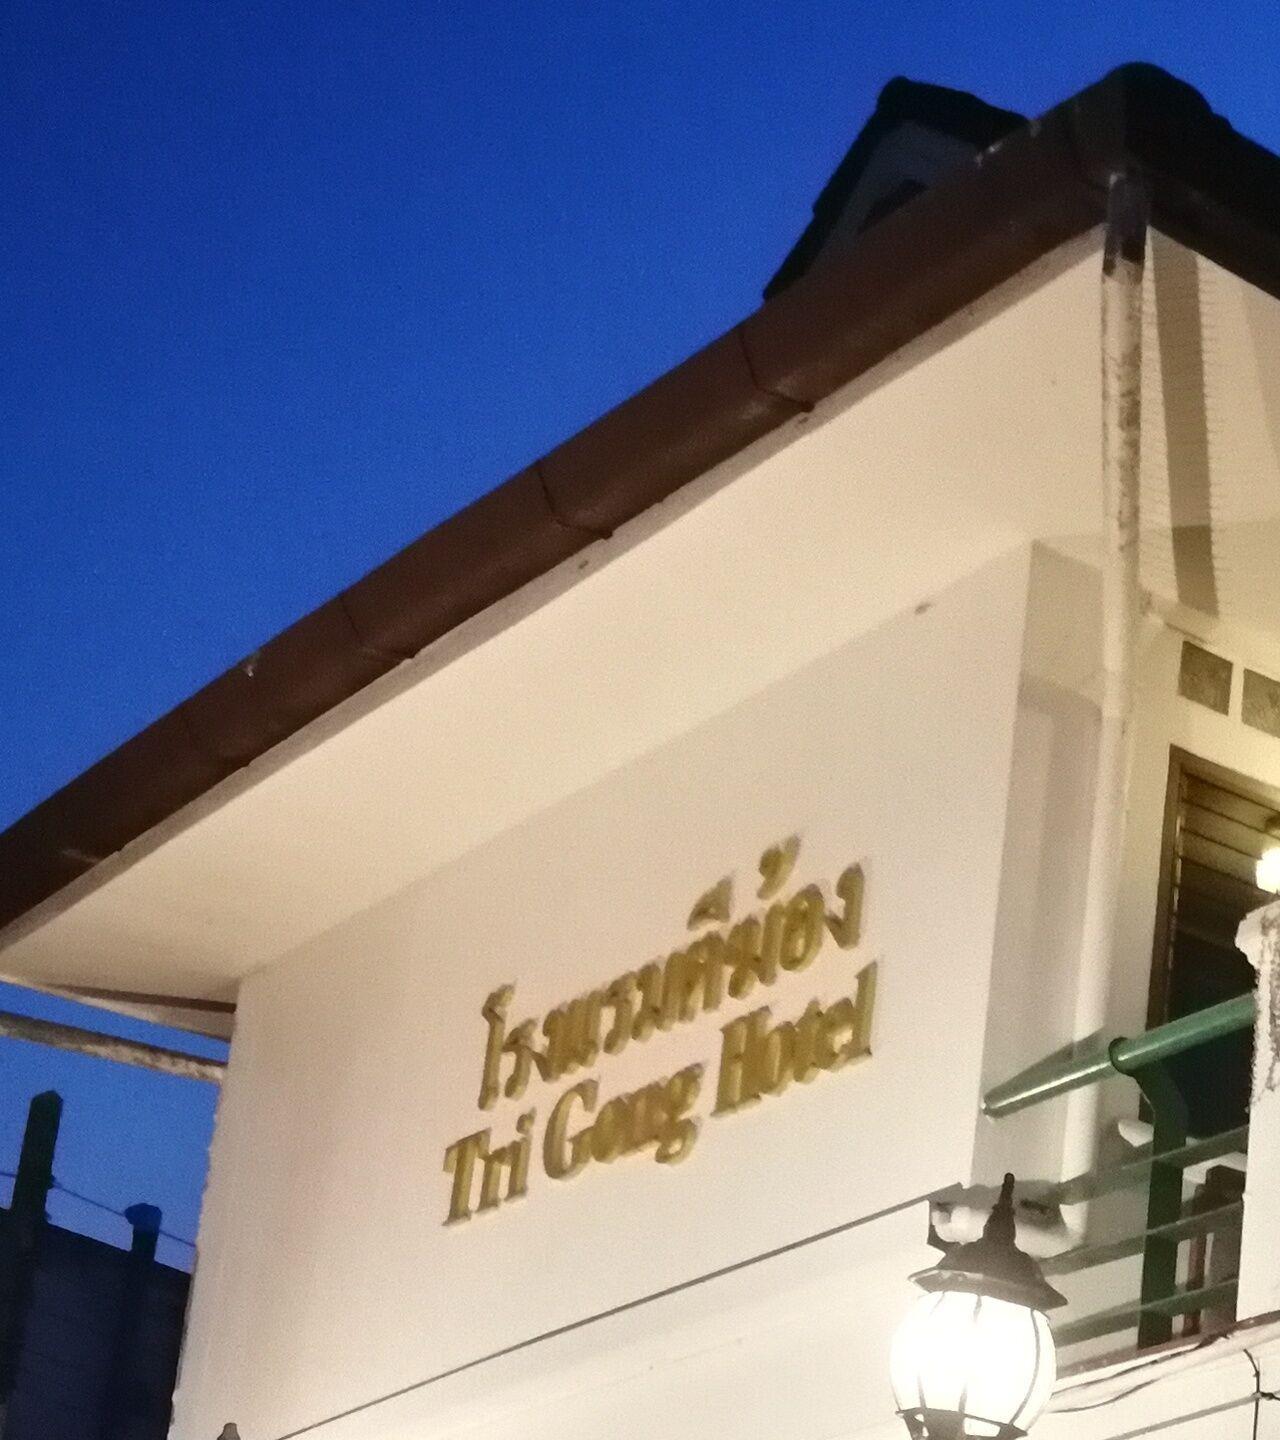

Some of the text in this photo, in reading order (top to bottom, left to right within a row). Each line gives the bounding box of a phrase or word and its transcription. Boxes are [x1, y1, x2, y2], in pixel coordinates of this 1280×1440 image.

[443, 960, 877, 1226] Tri Gong Hotel
